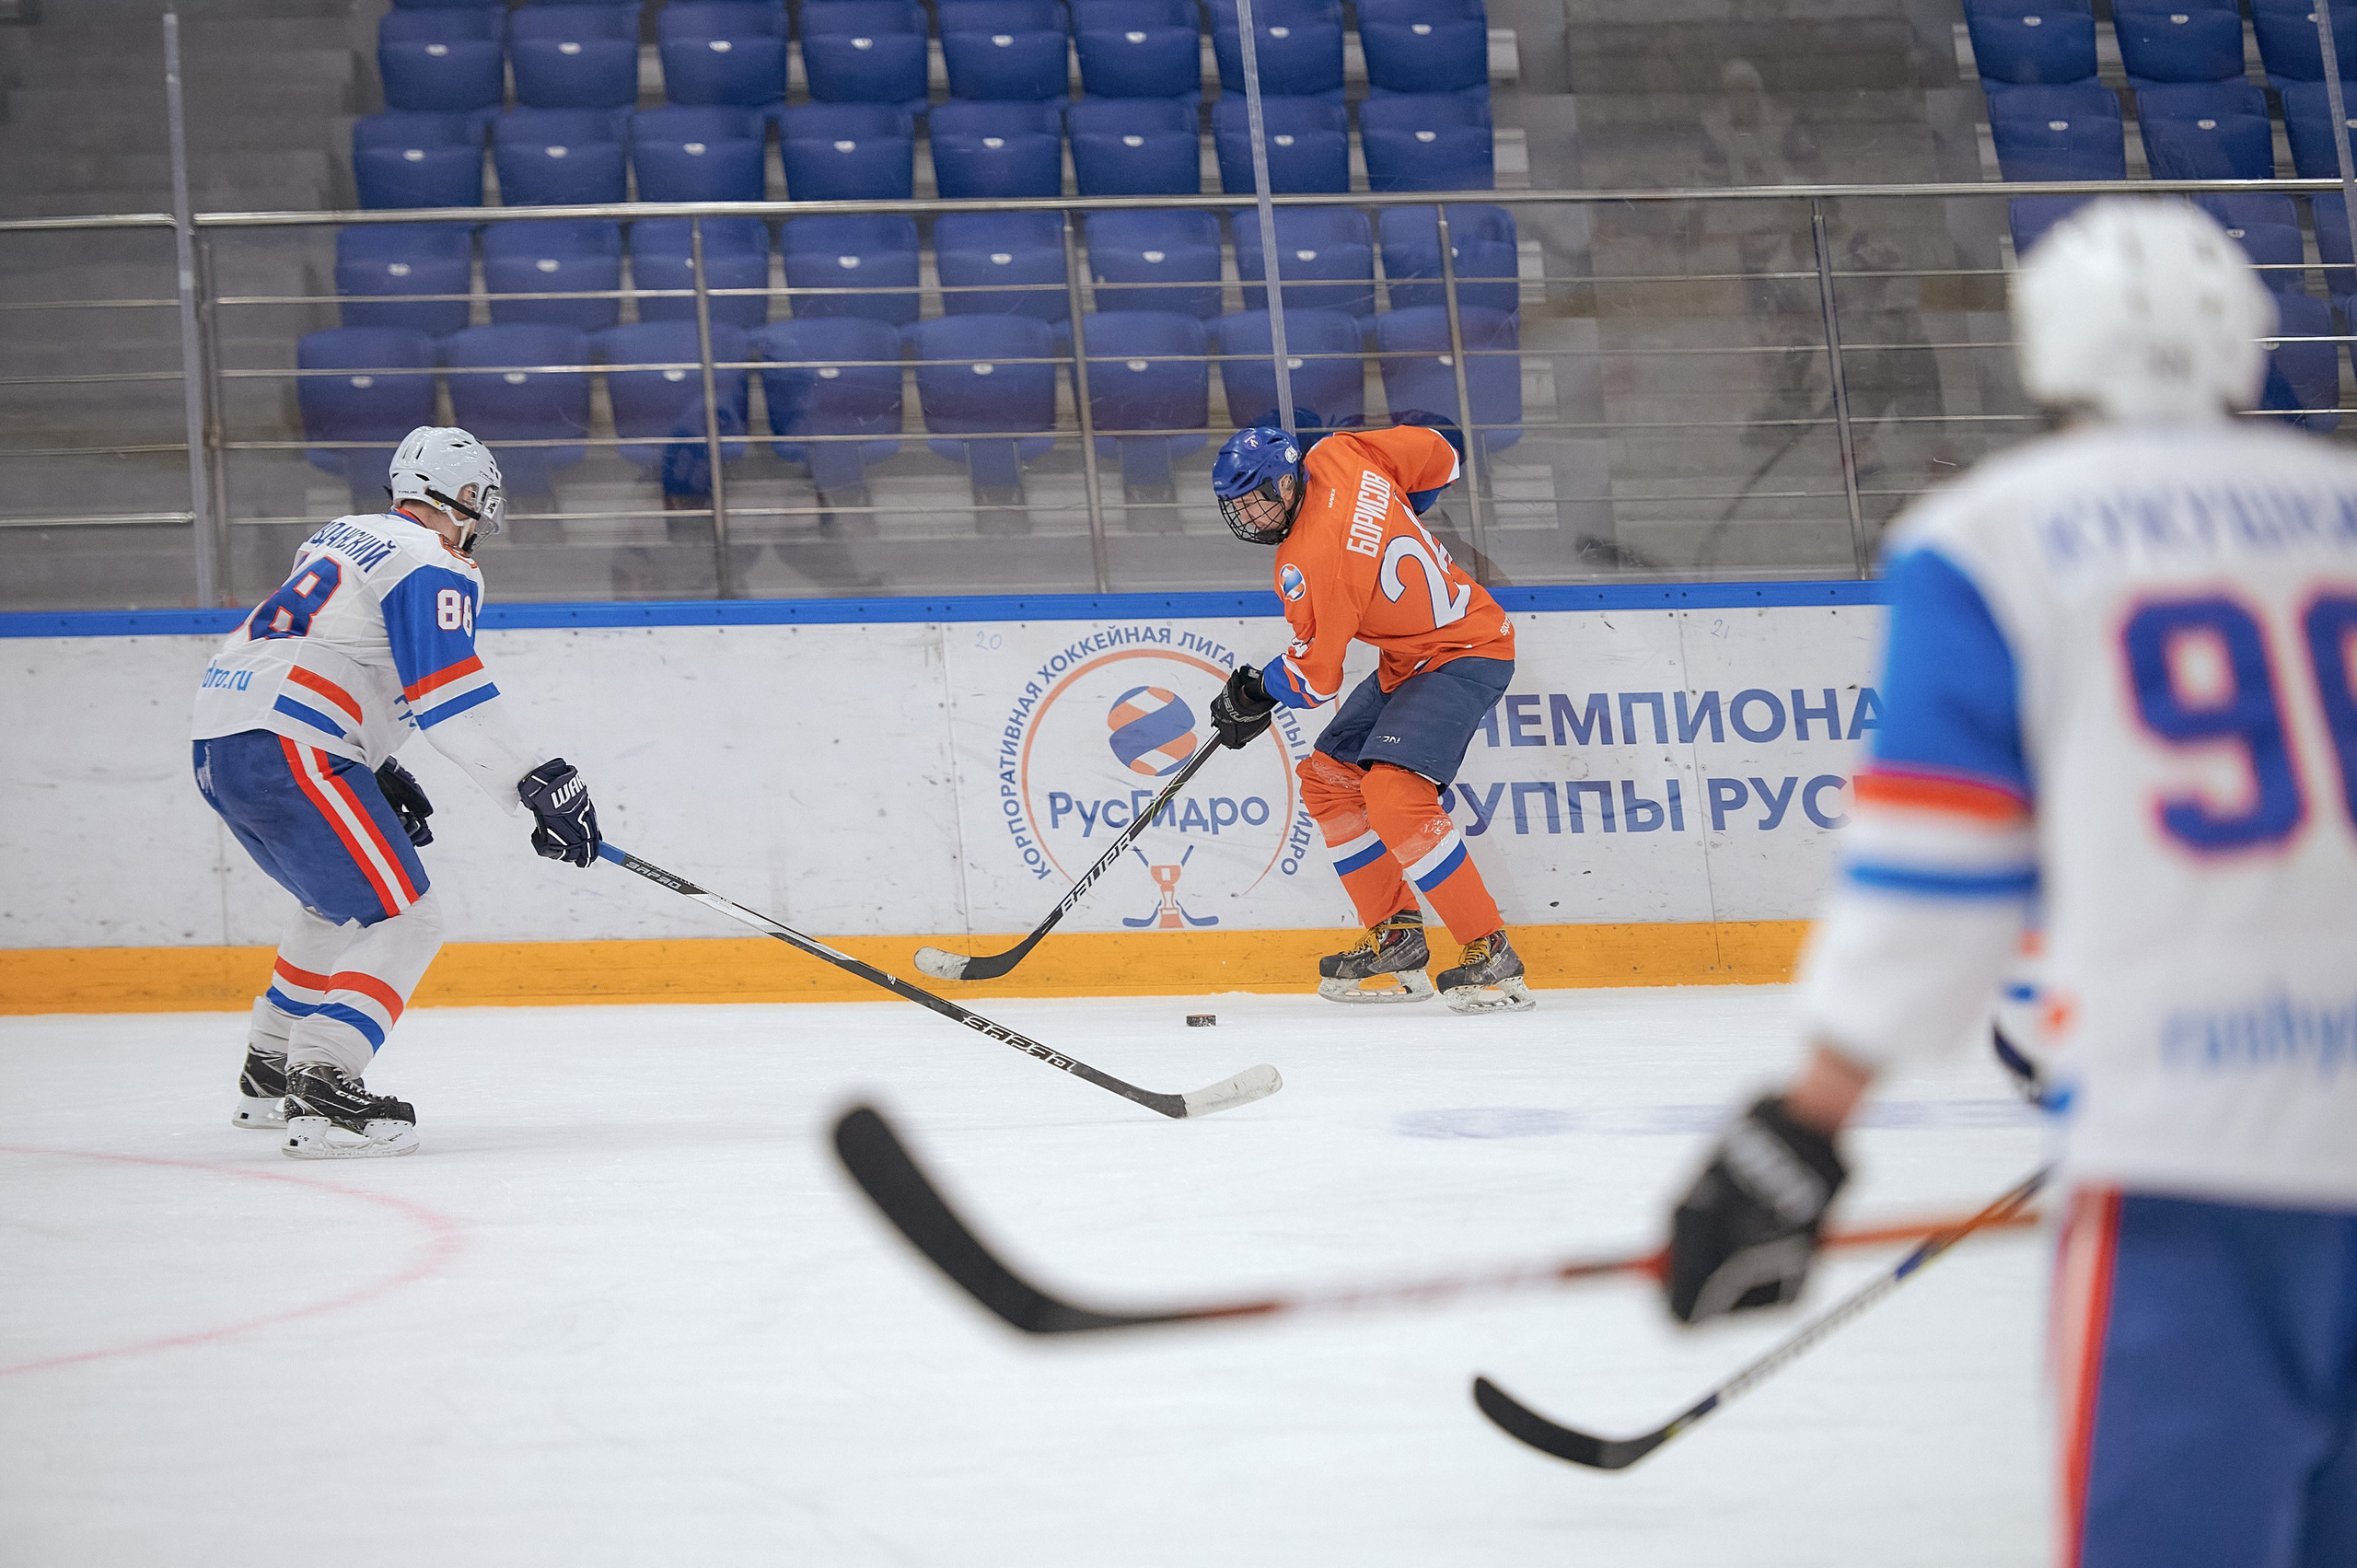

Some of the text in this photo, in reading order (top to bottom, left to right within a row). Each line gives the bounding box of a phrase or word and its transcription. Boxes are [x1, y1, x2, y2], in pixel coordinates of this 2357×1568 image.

[1346, 470, 1391, 558] БОРИСОВ
[436, 588, 476, 638] 88
[1711, 619, 1730, 640] 21
[975, 631, 1002, 651] 20
[999, 680, 1052, 881] КОРПОРАТИВНАЯ
[1037, 625, 1172, 684] ХОККЕЙНАЯ
[1177, 631, 1236, 669] ЛИГА
[1049, 789, 1270, 838] РусГидро
[335, 1089, 371, 1106] CCM
